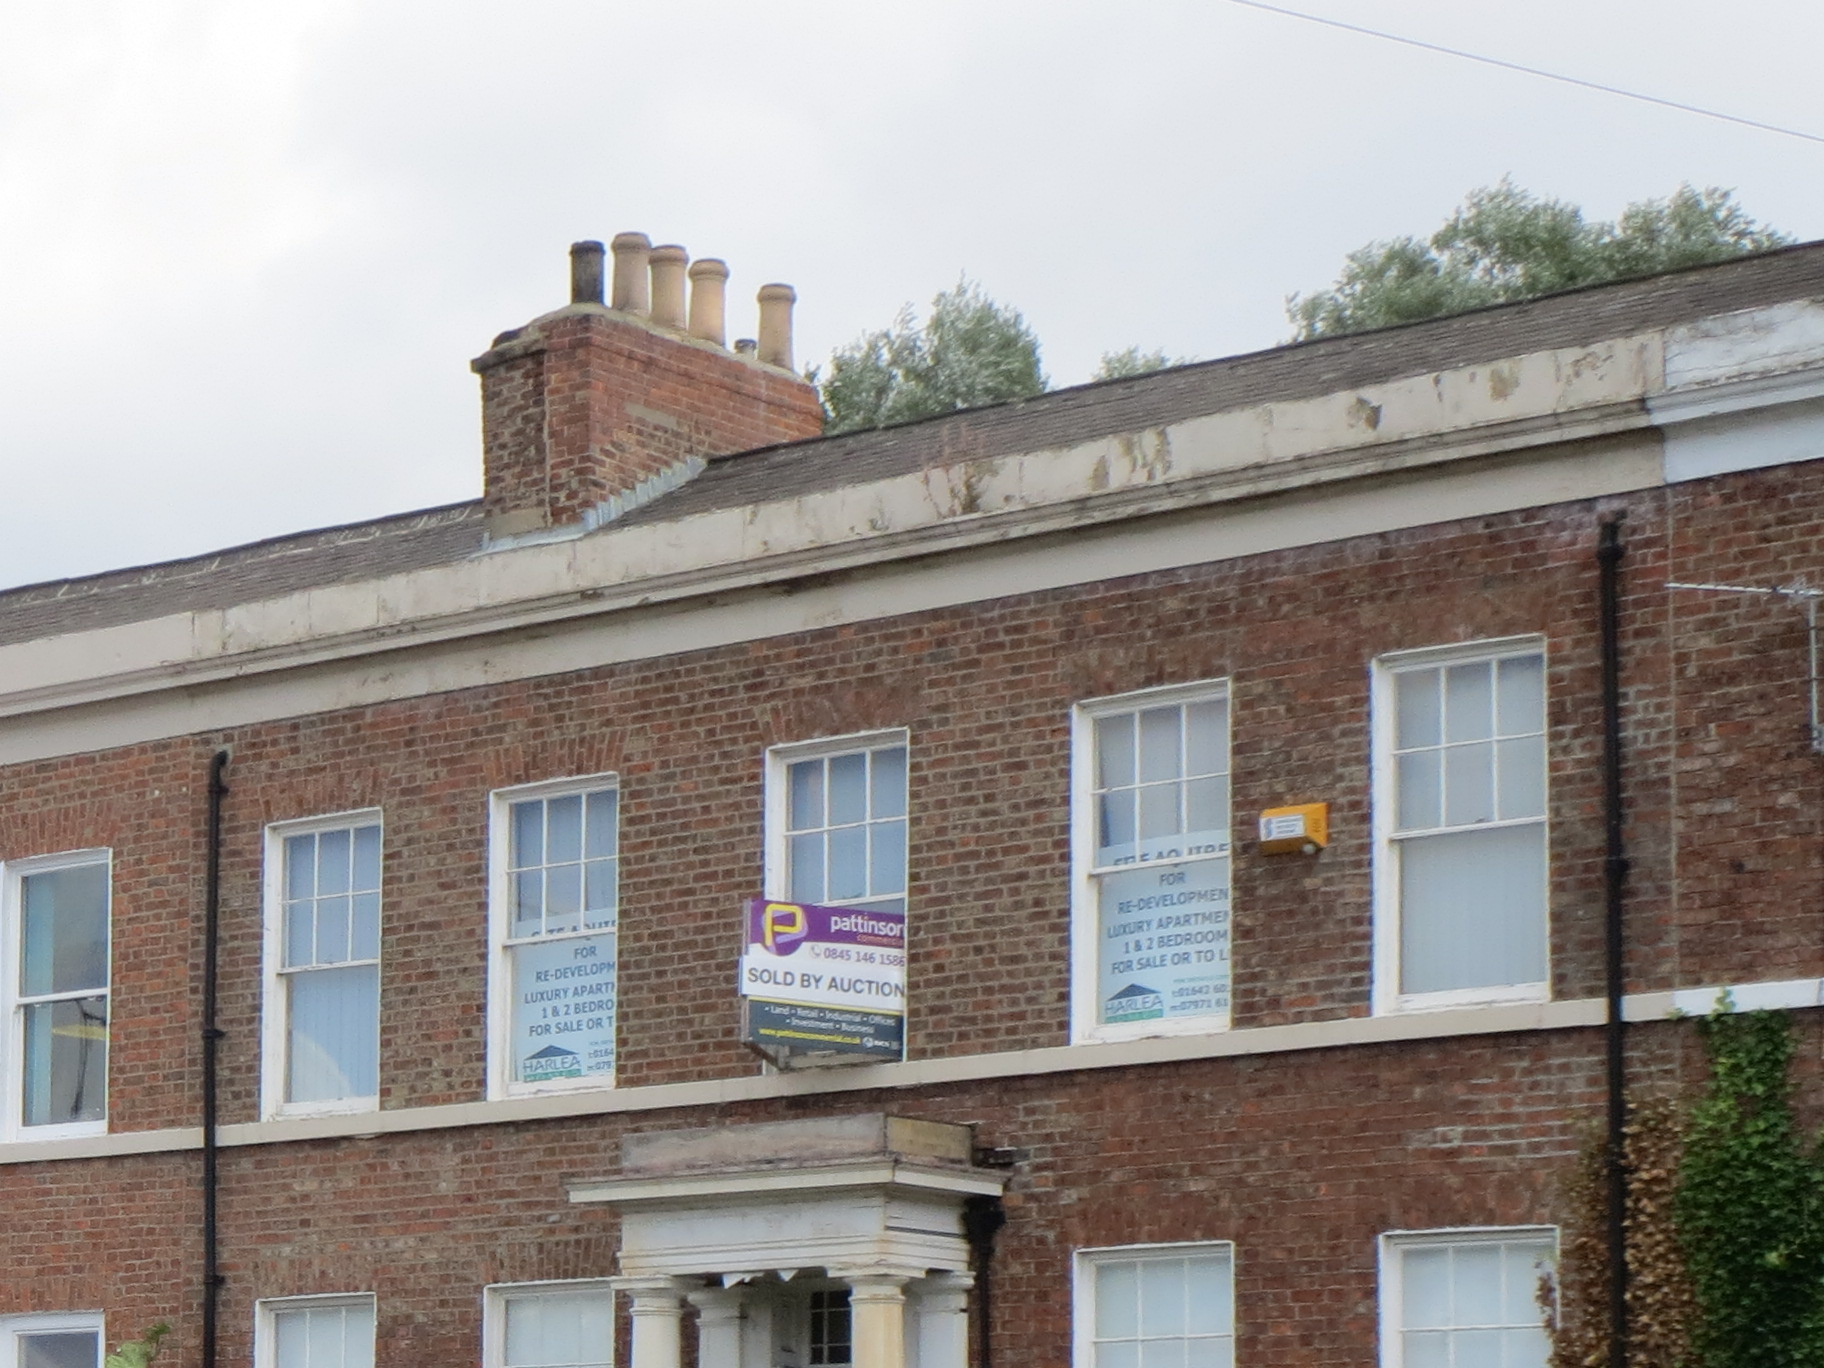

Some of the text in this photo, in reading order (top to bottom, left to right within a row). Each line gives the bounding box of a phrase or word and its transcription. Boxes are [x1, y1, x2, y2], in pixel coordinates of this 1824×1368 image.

[1159, 872, 1186, 887] FOR
[1117, 888, 1229, 914] RE-DEVELOPMEN
[1107, 919, 1152, 938] LUXURY
[574, 946, 597, 959] FOR
[1123, 942, 1131, 954] 1
[1134, 939, 1143, 952] &
[1146, 937, 1155, 950] 2
[824, 948, 851, 961] 0845
[855, 951, 876, 964] 146
[1111, 961, 1135, 975] FOR
[1136, 956, 1168, 972] SALE
[1171, 953, 1191, 965] OR
[1196, 950, 1215, 963] TO
[535, 962, 616, 983] RE-DEVELOPM
[747, 967, 905, 998] SOLD BY AUCTION
[524, 988, 570, 1004] LUXURY
[1105, 995, 1163, 1014] HARLEA
[542, 999, 614, 1019] 1 & 2 BEDRO
[529, 1024, 552, 1037] FOR
[555, 1019, 584, 1034] SALE
[586, 1017, 603, 1030] OR
[523, 1056, 581, 1073] HARLEA
